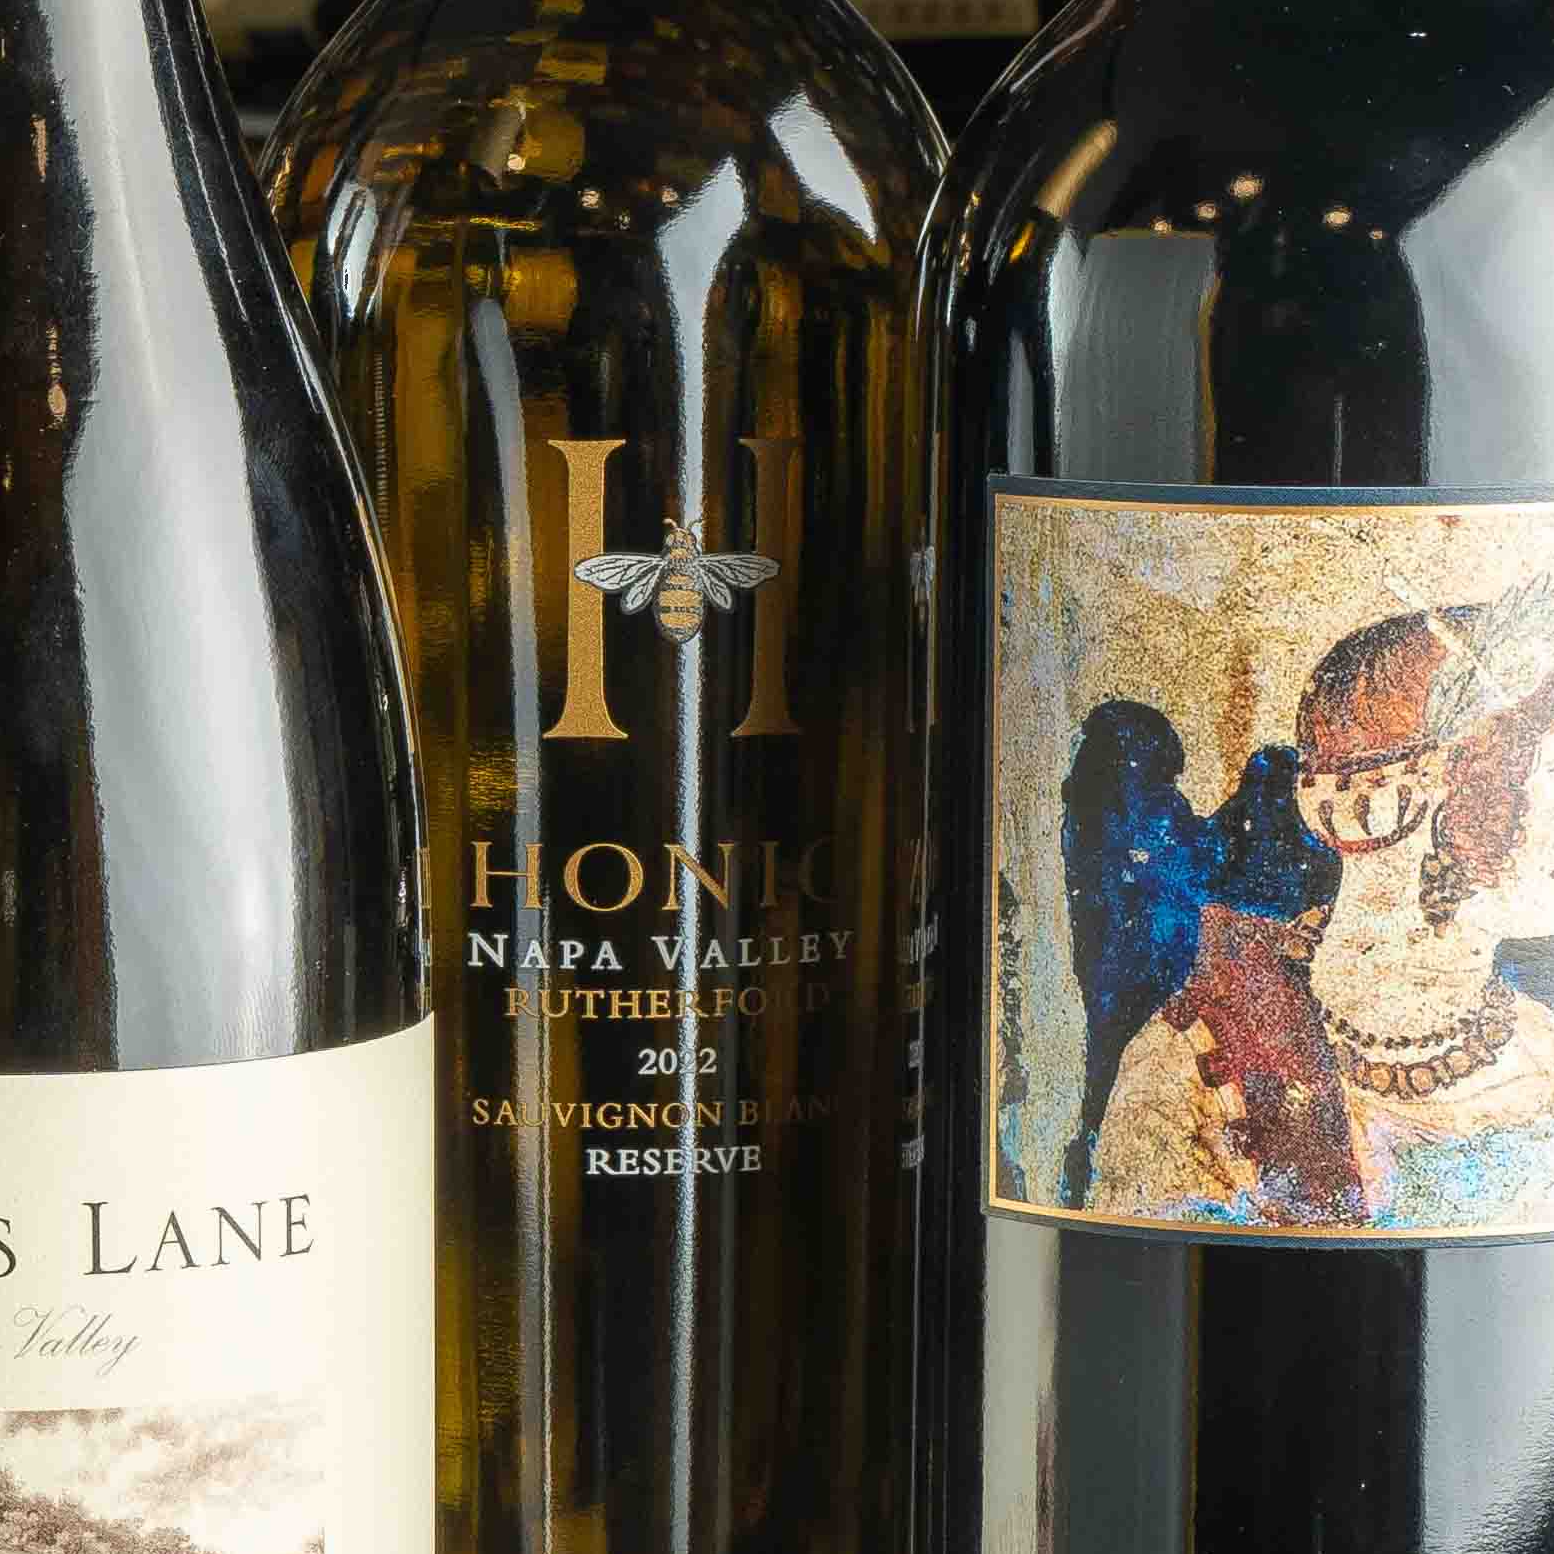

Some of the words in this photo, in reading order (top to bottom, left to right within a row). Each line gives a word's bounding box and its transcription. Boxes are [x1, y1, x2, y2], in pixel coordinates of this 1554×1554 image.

[467, 931, 624, 971] NAPA
[650, 929, 855, 971] VALLEY
[504, 982, 832, 1020] RUTHERFOD
[471, 1098, 722, 1129] SAUVIGNON
[740, 1095, 842, 1127] BAN
[585, 1145, 762, 1176] RESERVE
[82, 1193, 315, 1276] LANE
[12, 1305, 143, 1376] Valley
